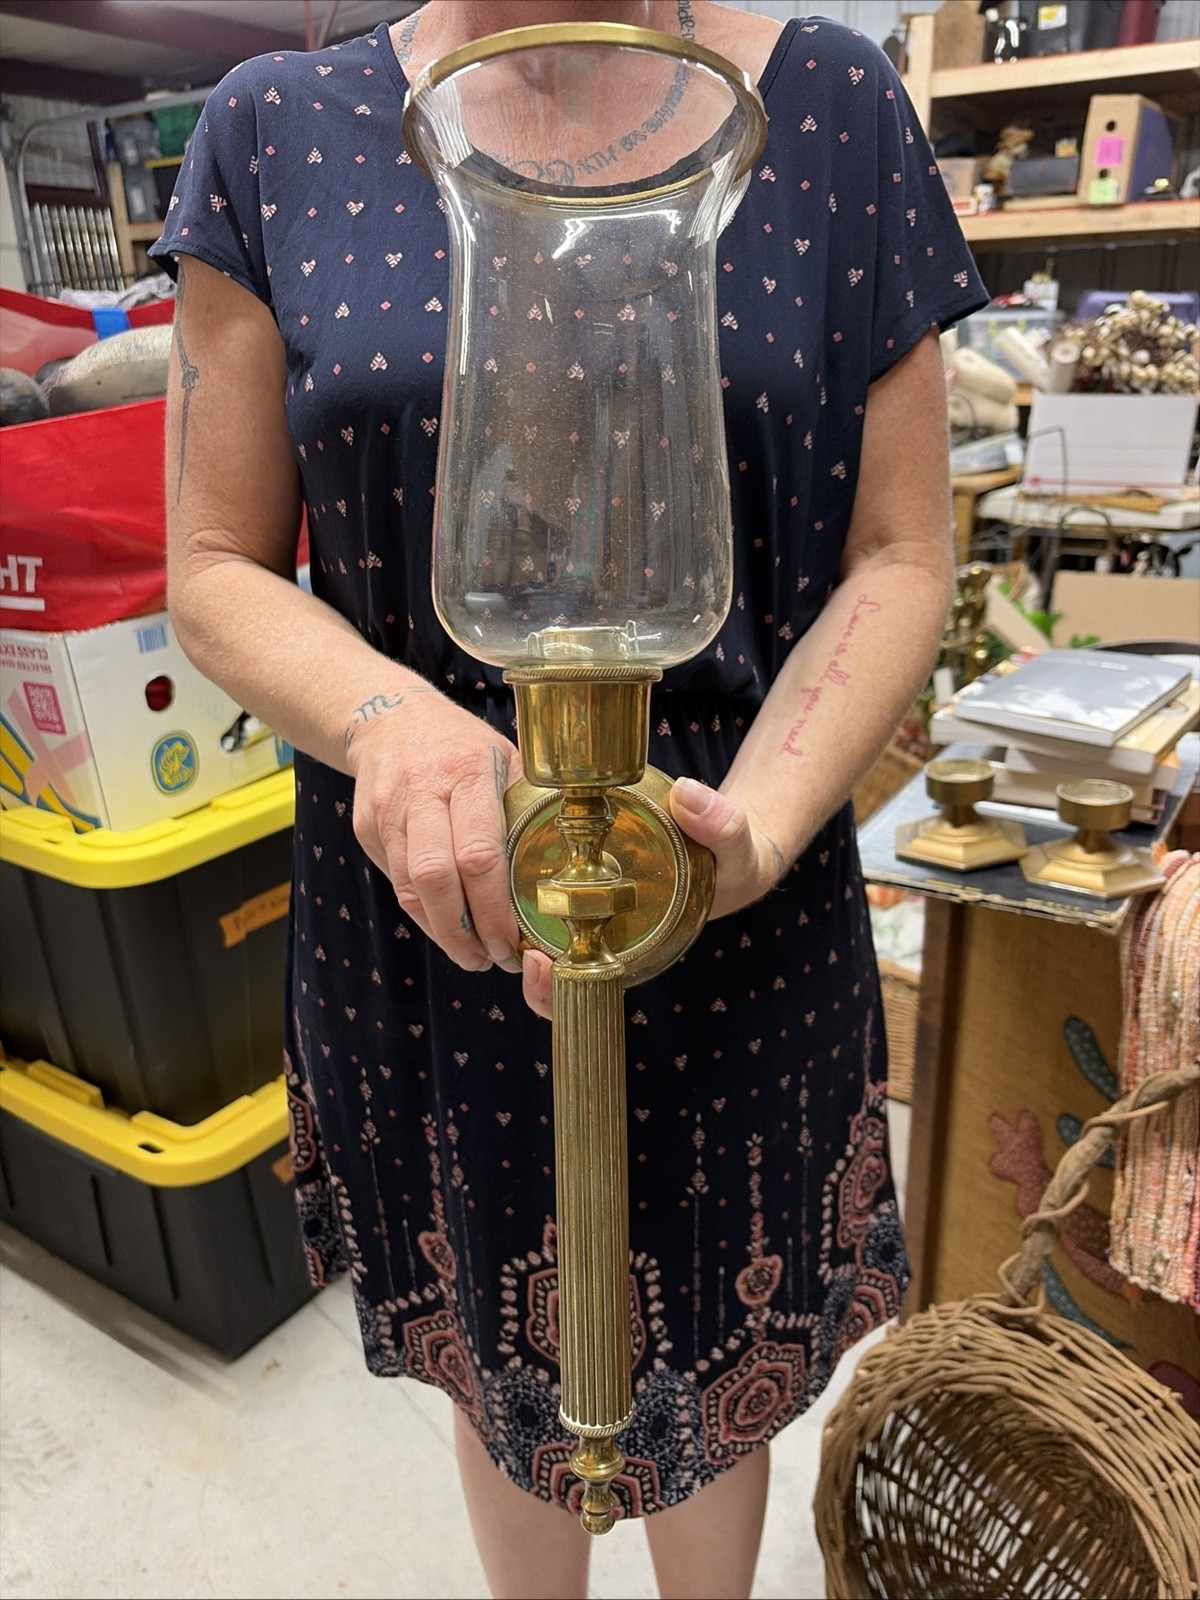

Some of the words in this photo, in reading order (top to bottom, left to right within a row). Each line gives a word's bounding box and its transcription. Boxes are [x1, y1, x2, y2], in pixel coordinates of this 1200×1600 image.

[844, 594, 881, 640] Love
[17, 645, 48, 661] CLASS
[820, 660, 850, 686] all
[801, 686, 822, 714] you
[779, 719, 807, 756] need
